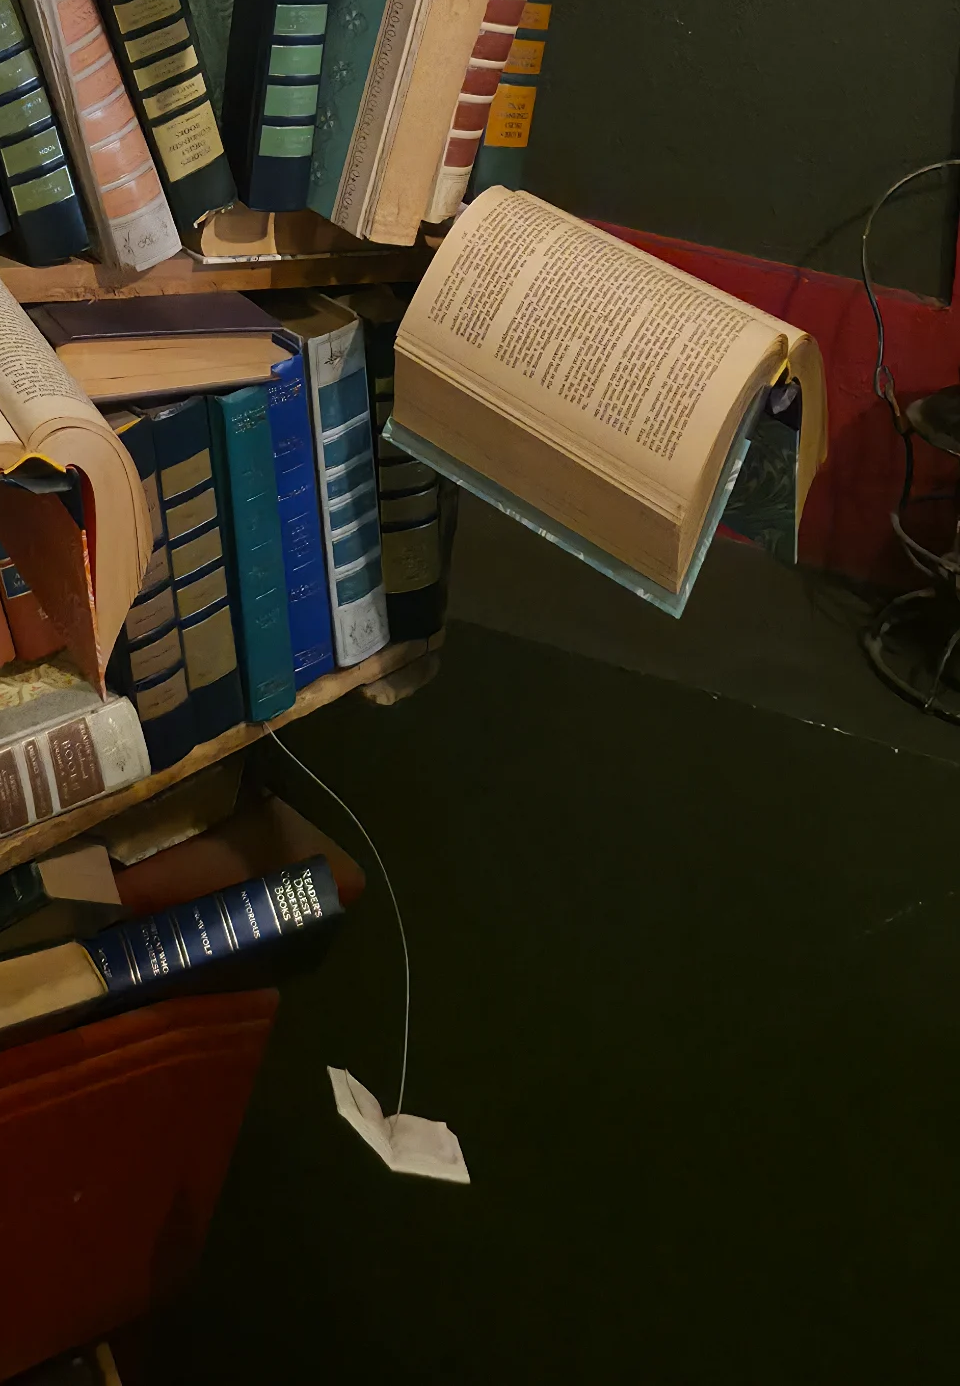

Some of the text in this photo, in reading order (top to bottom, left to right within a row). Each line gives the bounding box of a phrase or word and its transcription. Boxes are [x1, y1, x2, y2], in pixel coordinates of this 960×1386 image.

[274, 887, 291, 921] BOOKS
[294, 878, 311, 915] DIGEST
[303, 868, 322, 917] READER'S
[241, 891, 260, 939] NOTORIOUS
[200, 927, 212, 956] WOLF
